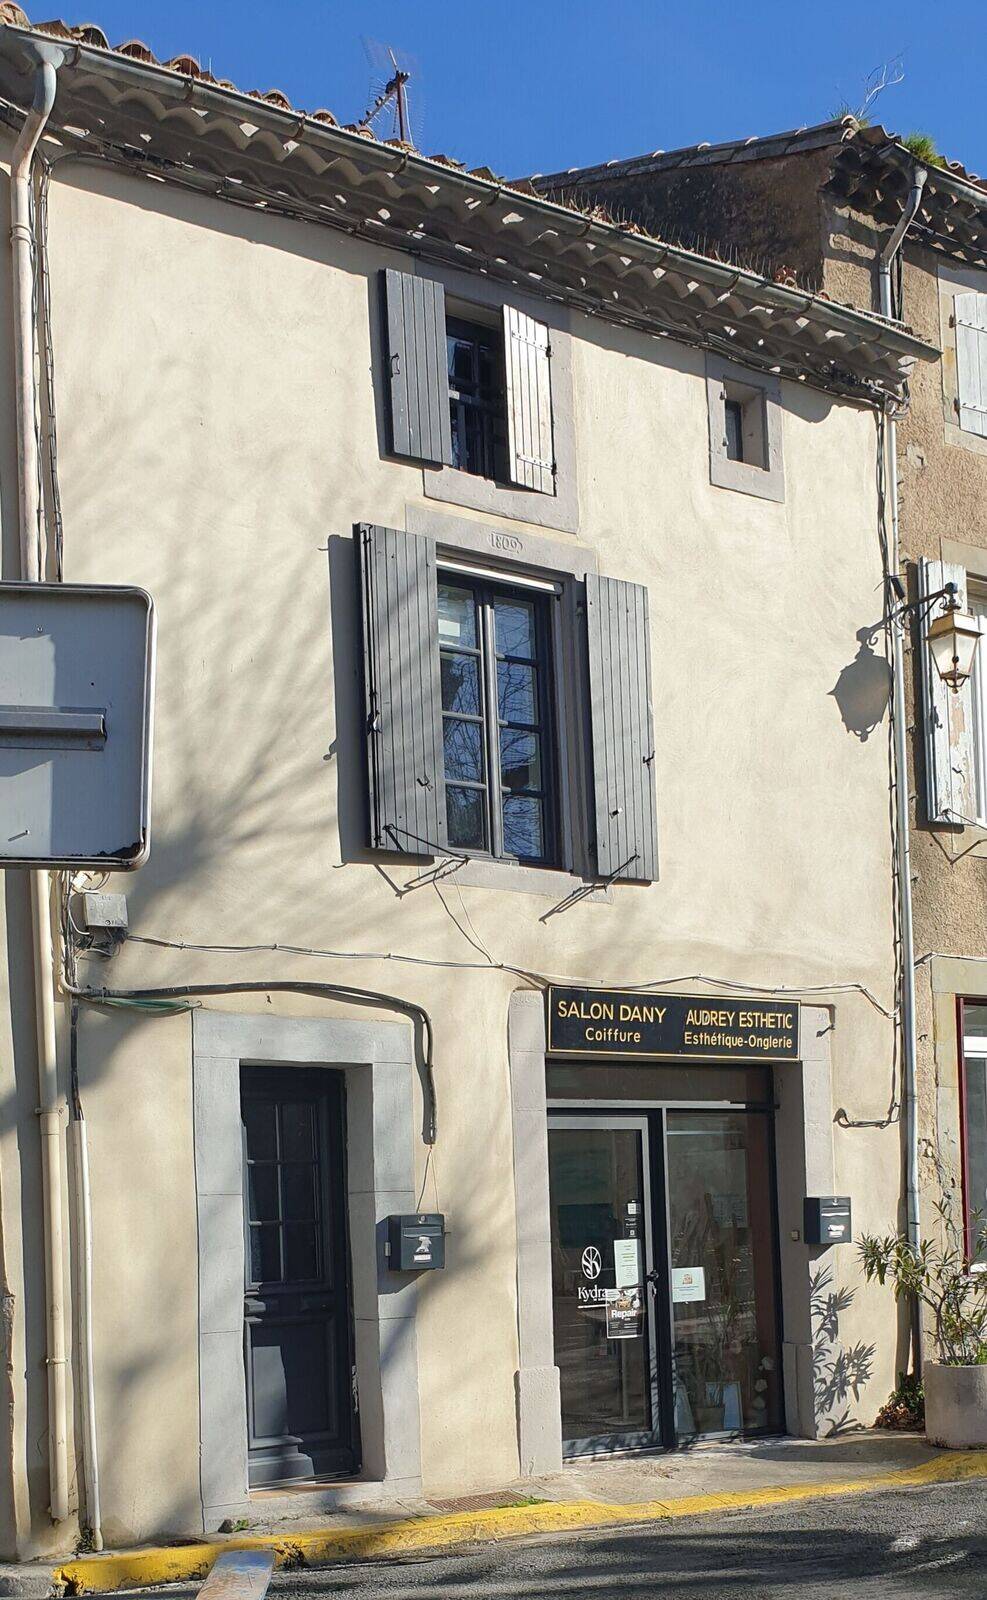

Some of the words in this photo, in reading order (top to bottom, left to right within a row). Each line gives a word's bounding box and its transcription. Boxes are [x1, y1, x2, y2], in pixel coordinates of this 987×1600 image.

[557, 1000, 614, 1020] SALON
[619, 1004, 666, 1023] DANY
[685, 1009, 735, 1027] AUDREY
[739, 1012, 793, 1029] ESTHETIC
[585, 1027, 641, 1043] Coiffure
[684, 1032, 793, 1049] Esthétique-Onglerie
[577, 1285, 606, 1302] Kydra
[611, 1309, 637, 1320] Repair
